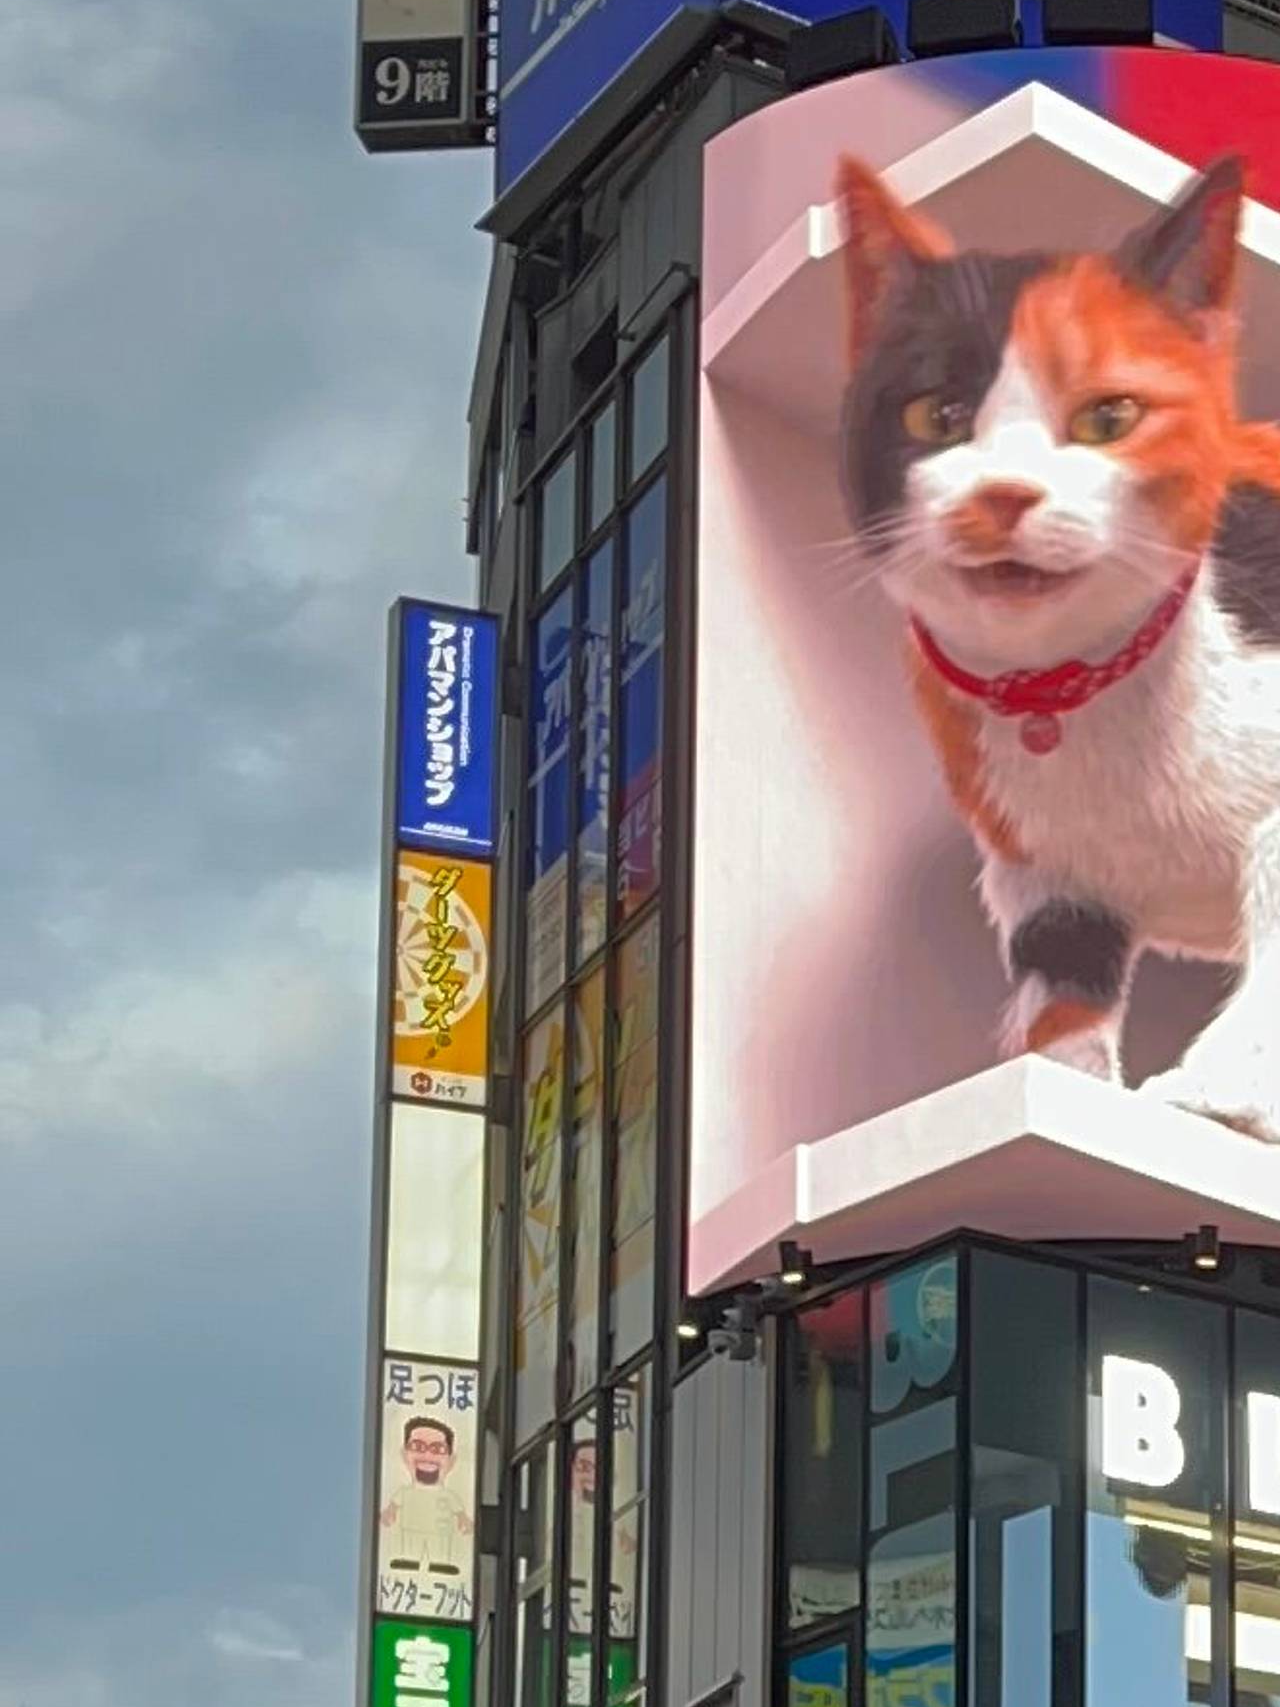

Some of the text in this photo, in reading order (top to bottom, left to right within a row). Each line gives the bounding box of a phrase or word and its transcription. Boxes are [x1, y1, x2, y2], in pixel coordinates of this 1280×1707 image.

[426, 620, 457, 806] アパマンショップ
[385, 1363, 475, 1412] 足つぼ
[378, 1574, 471, 1621] ドクターフット
